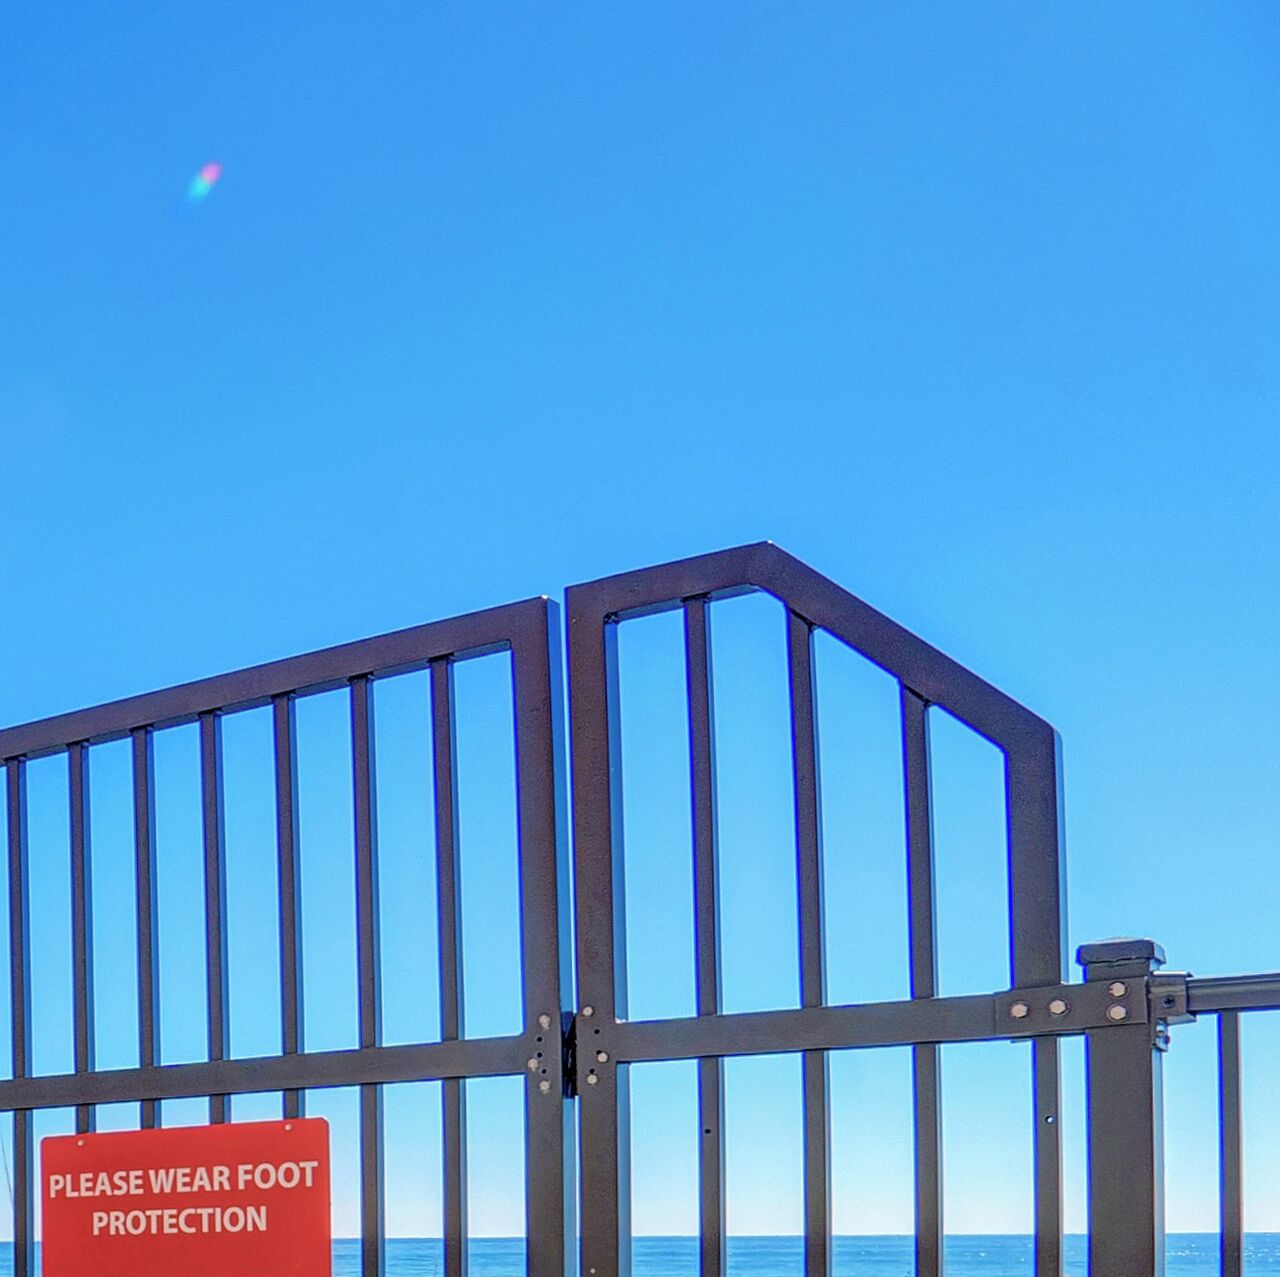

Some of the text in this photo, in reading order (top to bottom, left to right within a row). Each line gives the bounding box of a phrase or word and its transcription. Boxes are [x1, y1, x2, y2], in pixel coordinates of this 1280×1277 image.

[49, 1161, 319, 1198] PLEASE WEAR FOOT
[92, 1206, 268, 1235] PROTECTION
